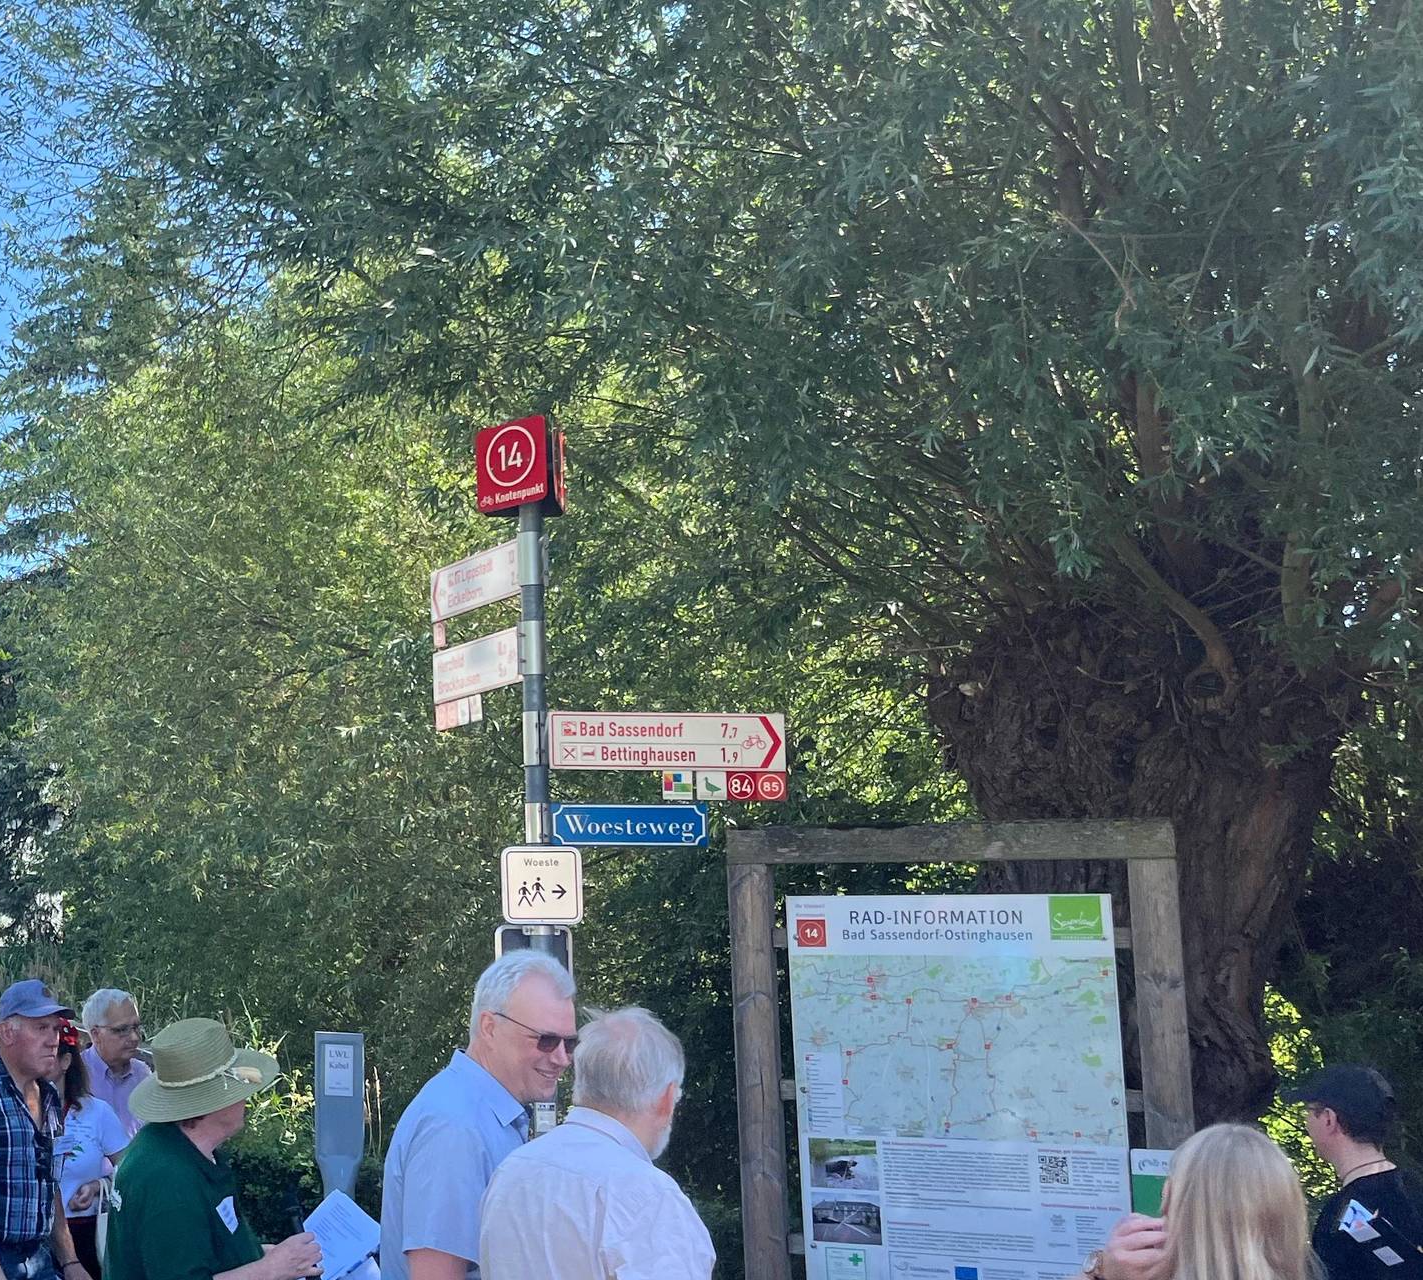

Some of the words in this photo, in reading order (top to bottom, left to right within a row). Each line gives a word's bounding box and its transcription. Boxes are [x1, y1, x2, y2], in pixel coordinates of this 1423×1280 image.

[498, 441, 523, 472] 14
[495, 483, 544, 504] Knotenpunkt
[580, 722, 604, 736] Bad
[609, 722, 683, 737] Sassendorf
[601, 746, 696, 765] Bettinghausen
[731, 779, 752, 794] 84
[763, 781, 780, 793] 85
[564, 814, 695, 843] Woesteweg
[524, 858, 559, 867] Woeste
[849, 910, 1024, 925] RAD-INFORMATION
[805, 928, 819, 938] 14
[842, 929, 865, 940] Bad
[870, 929, 1033, 943] Sassendorf-Ostinghausen
[329, 1062, 349, 1070] Kabel
